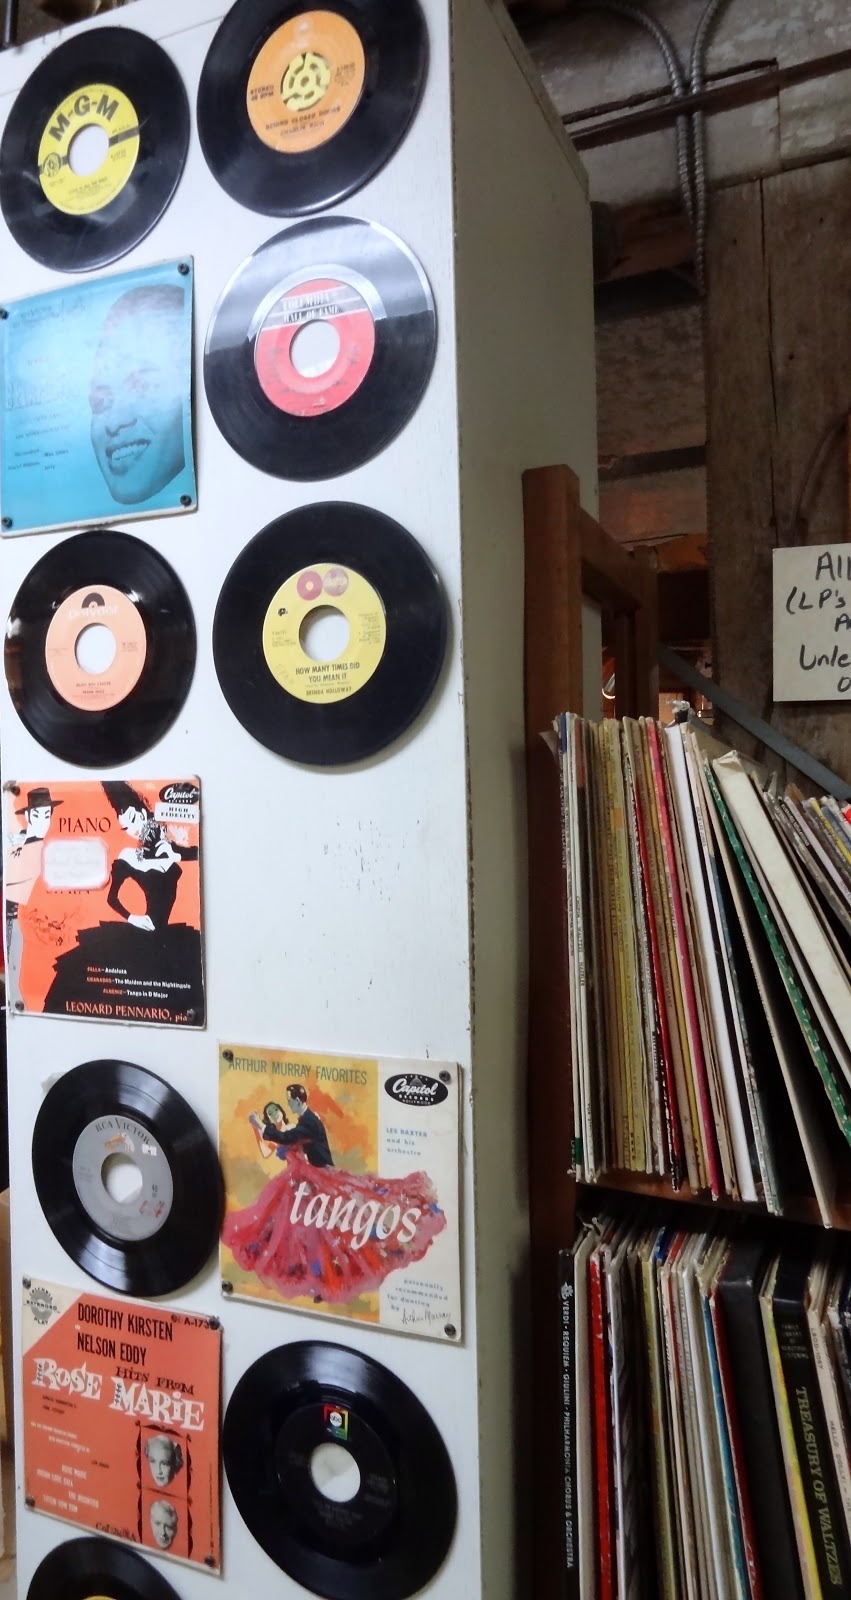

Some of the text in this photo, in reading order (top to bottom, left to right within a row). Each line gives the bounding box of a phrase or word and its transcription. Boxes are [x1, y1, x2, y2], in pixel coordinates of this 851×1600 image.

[50, 94, 119, 142] M-G-M
[295, 667, 310, 675] HOW
[311, 665, 330, 673] MANY
[331, 663, 349, 671] TIMES
[308, 675, 322, 683] YOU
[323, 674, 341, 682] MEAN
[325, 686, 352, 695] HOLLOWAY
[164, 787, 196, 800] Capitol
[59, 816, 111, 833] PIANO
[127, 989, 142, 997] Tango
[162, 981, 191, 990] Nightingale
[65, 1001, 113, 1016] LEONARD
[115, 1005, 172, 1021] PENNARIO,
[228, 1057, 367, 1085] ARTHUR MURRAY FAVORITES
[392, 1078, 438, 1095] Capitol
[95, 1117, 150, 1144] RCA VICTOR
[400, 1129, 428, 1137] BAXTER
[386, 1147, 421, 1156] orchestra
[289, 1181, 422, 1251] tangos
[77, 1303, 173, 1342] DOROTHY KIRSTEN
[562, 1300, 570, 1324] VERDI
[77, 1332, 147, 1366] NELSON EDDY
[562, 1330, 570, 1368] REQUIEM
[563, 1373, 571, 1405] GIULINI
[563, 1411, 571, 1474] PHILHARMONIA
[564, 1476, 572, 1510] CHORUS
[796, 1386, 843, 1586] TREASURY OF WALTZES
[565, 1520, 574, 1569] ORCHESTRA
